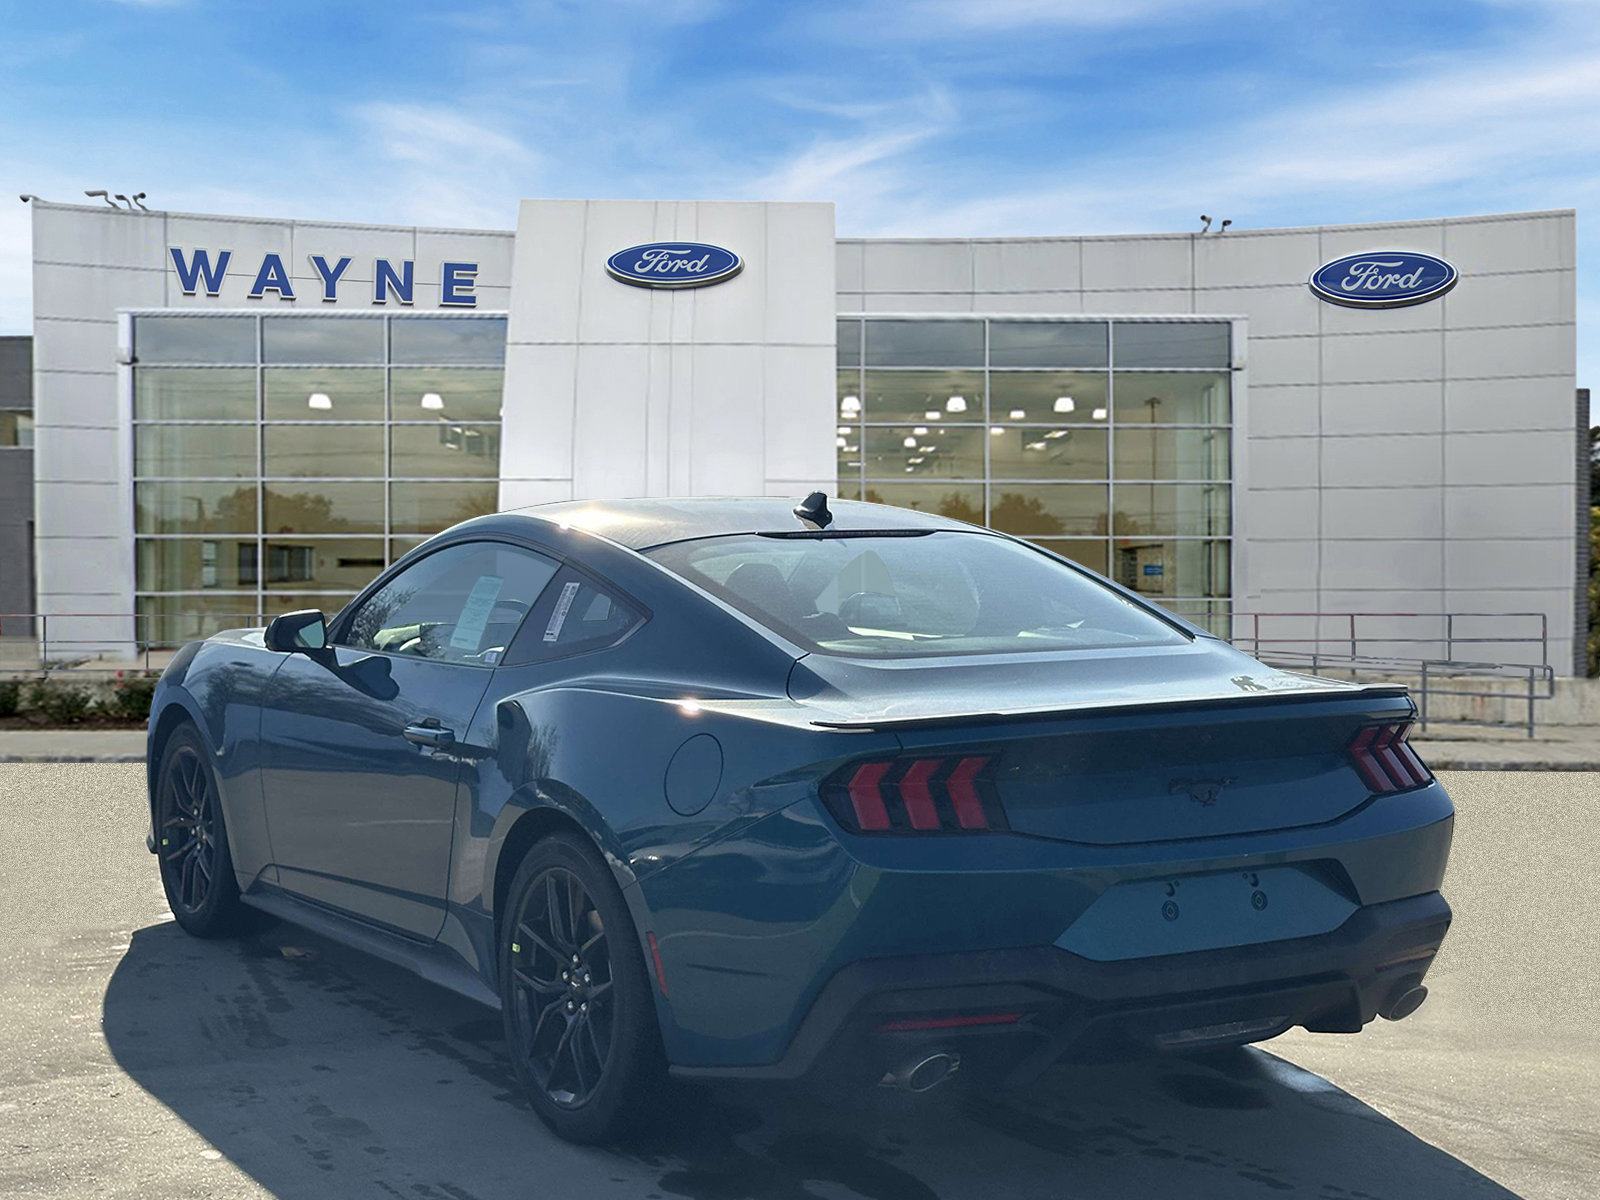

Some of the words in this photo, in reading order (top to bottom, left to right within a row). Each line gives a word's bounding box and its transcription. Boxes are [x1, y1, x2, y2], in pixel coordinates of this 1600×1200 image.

[169, 246, 479, 306] WAYNE
[634, 249, 710, 273] Ford
[1341, 261, 1424, 291] Ford
